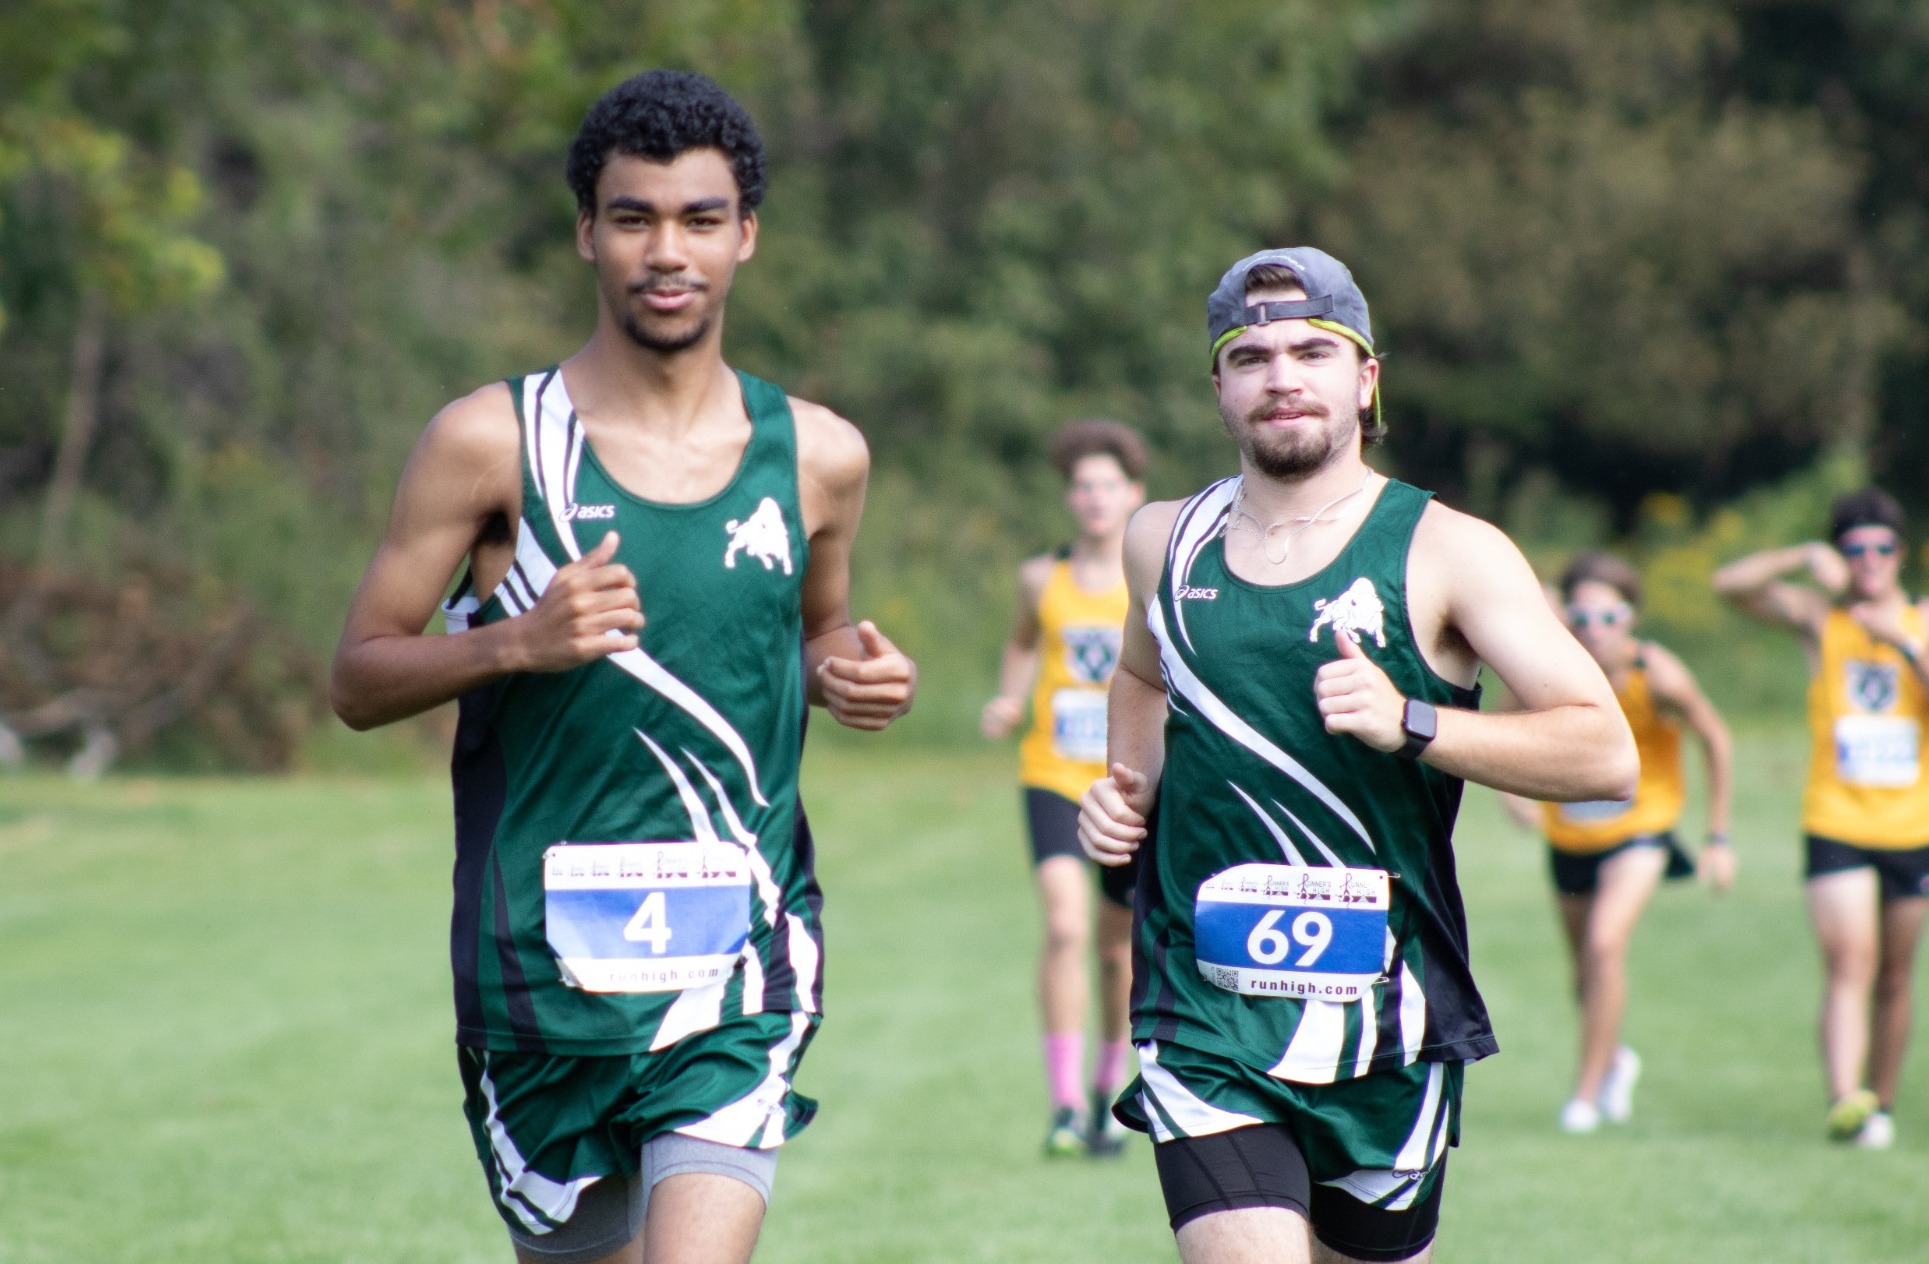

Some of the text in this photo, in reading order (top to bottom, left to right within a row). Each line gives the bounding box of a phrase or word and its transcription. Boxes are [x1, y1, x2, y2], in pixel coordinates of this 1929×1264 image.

[1187, 588, 1219, 600] asics
[623, 891, 672, 955] 4
[1247, 909, 1333, 967] 69
[610, 968, 719, 983] runhigh.com
[1251, 979, 1358, 995] runhigh.com
